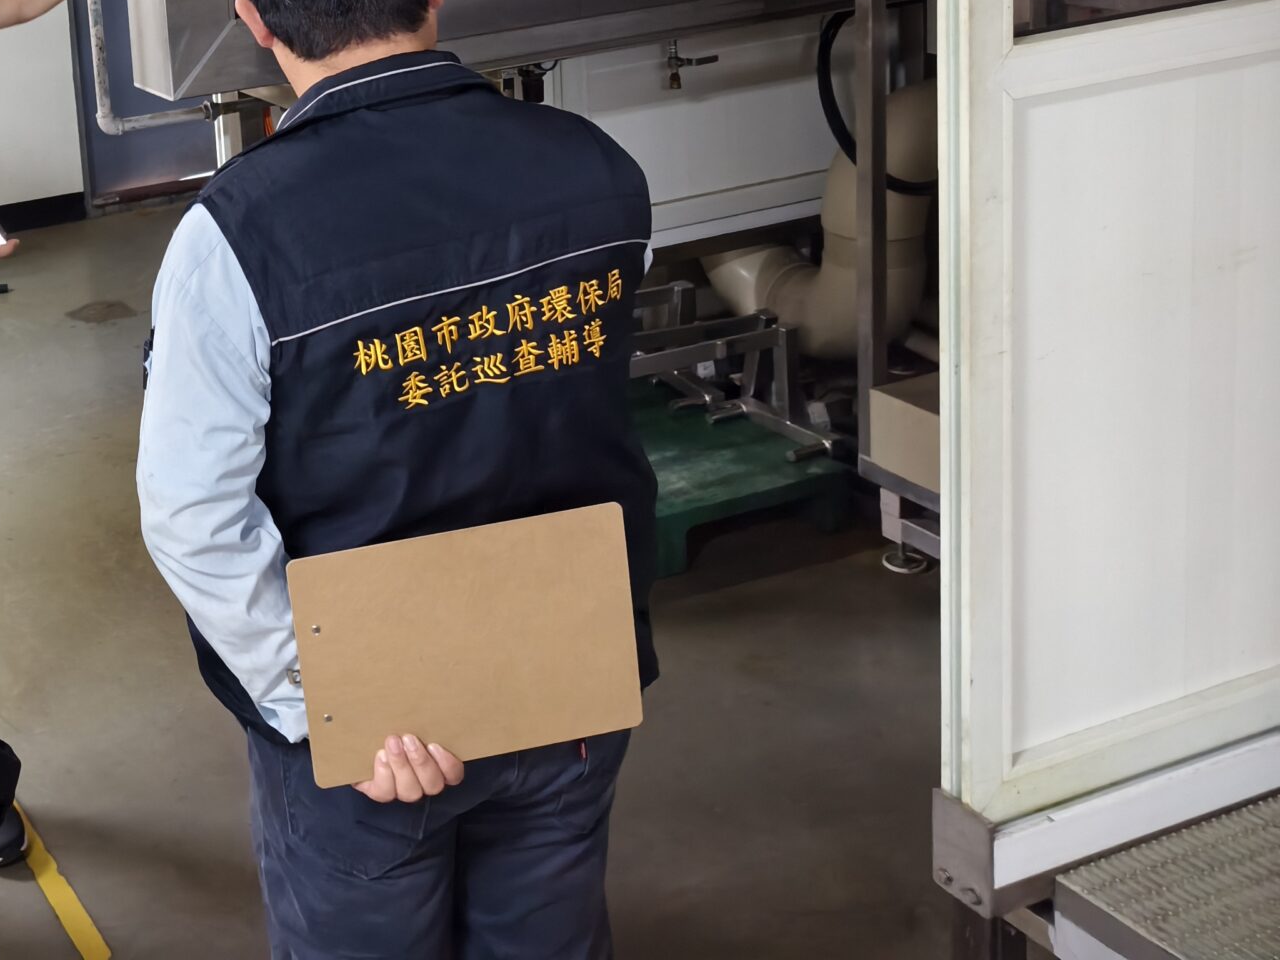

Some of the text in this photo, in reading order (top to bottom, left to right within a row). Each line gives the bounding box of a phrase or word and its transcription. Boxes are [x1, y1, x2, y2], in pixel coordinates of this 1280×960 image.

[353, 268, 622, 375] 桃園市政府環保局
[397, 318, 607, 409] 委託巡查輔導
